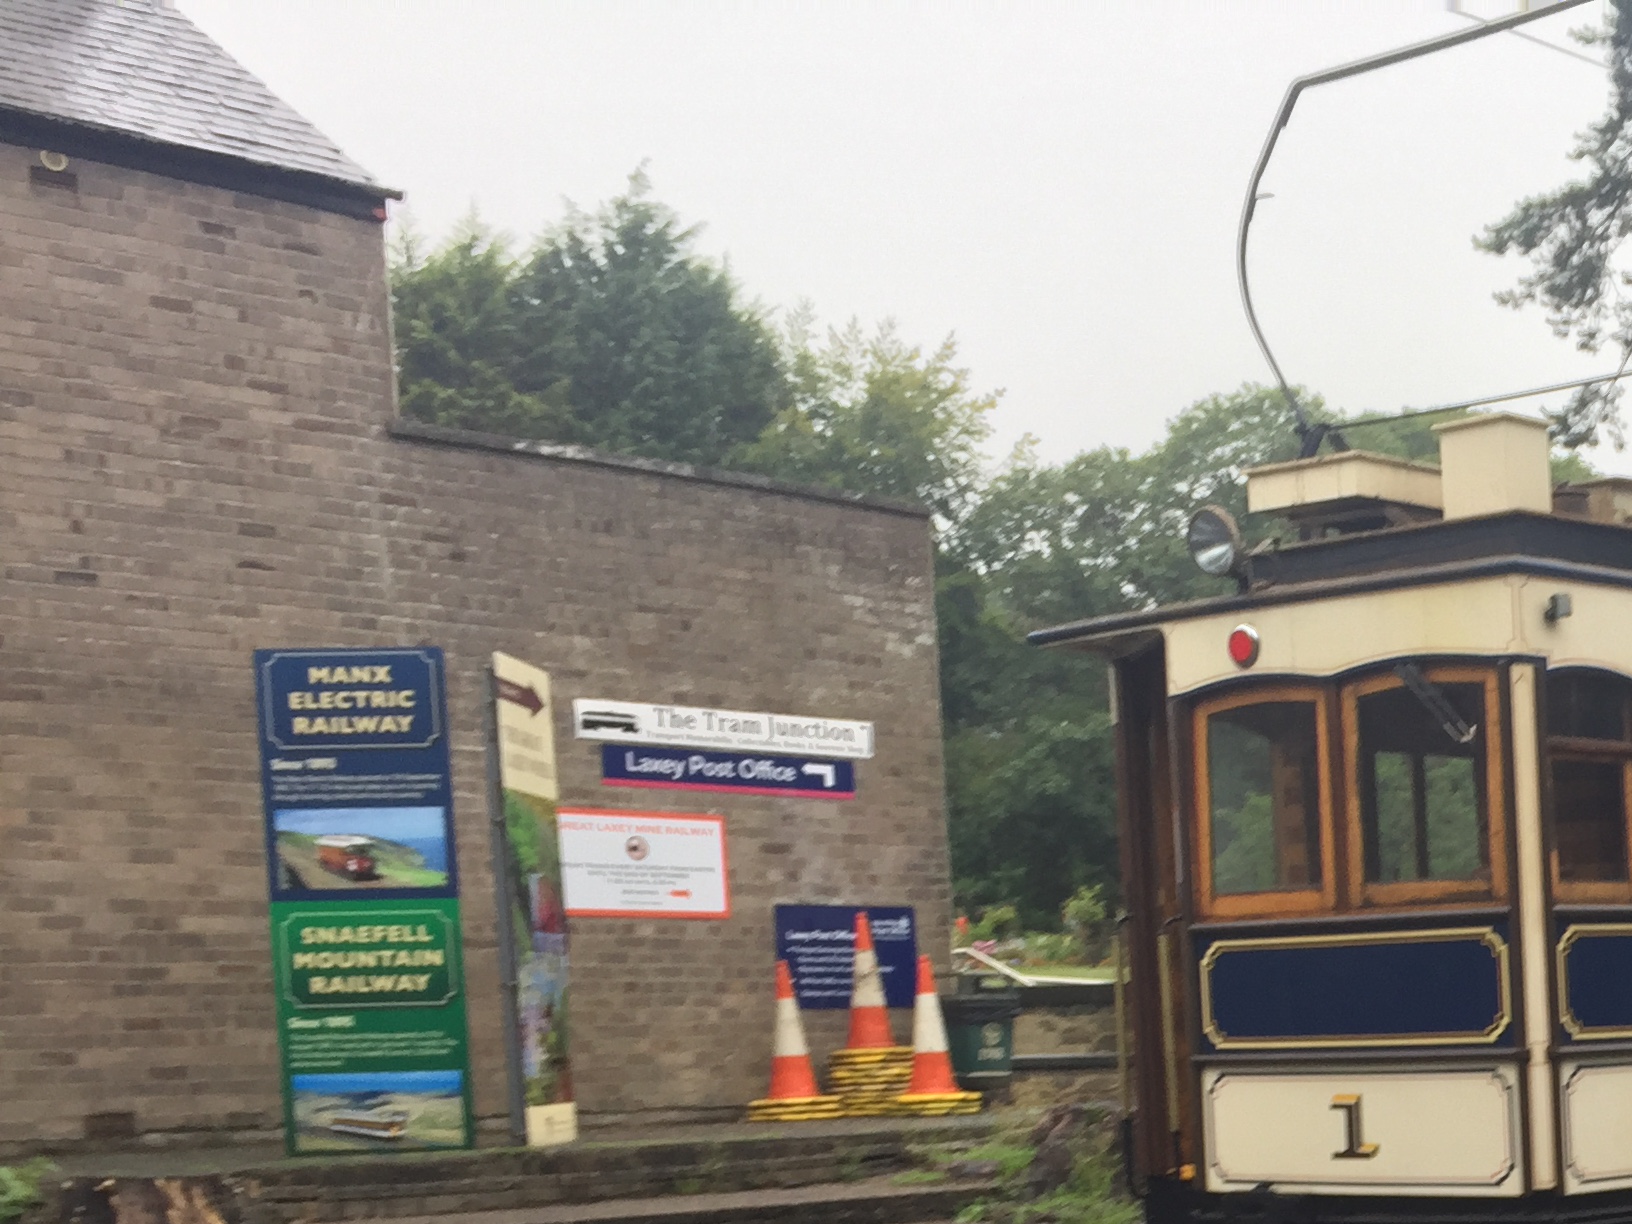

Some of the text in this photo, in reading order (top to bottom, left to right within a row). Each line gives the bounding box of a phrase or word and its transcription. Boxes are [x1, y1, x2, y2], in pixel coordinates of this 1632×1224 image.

[307, 665, 393, 685] MANX
[287, 689, 416, 710] ELECTRIC
[292, 714, 415, 735] RAILWAY
[653, 707, 855, 742] The Tram Junction
[624, 750, 797, 782] Laxey Post Office
[301, 924, 434, 944] SNAEFELL
[293, 949, 445, 969] MOUNTAIN
[309, 973, 432, 994] RAILWAY
[1328, 1093, 1380, 1161] 1
